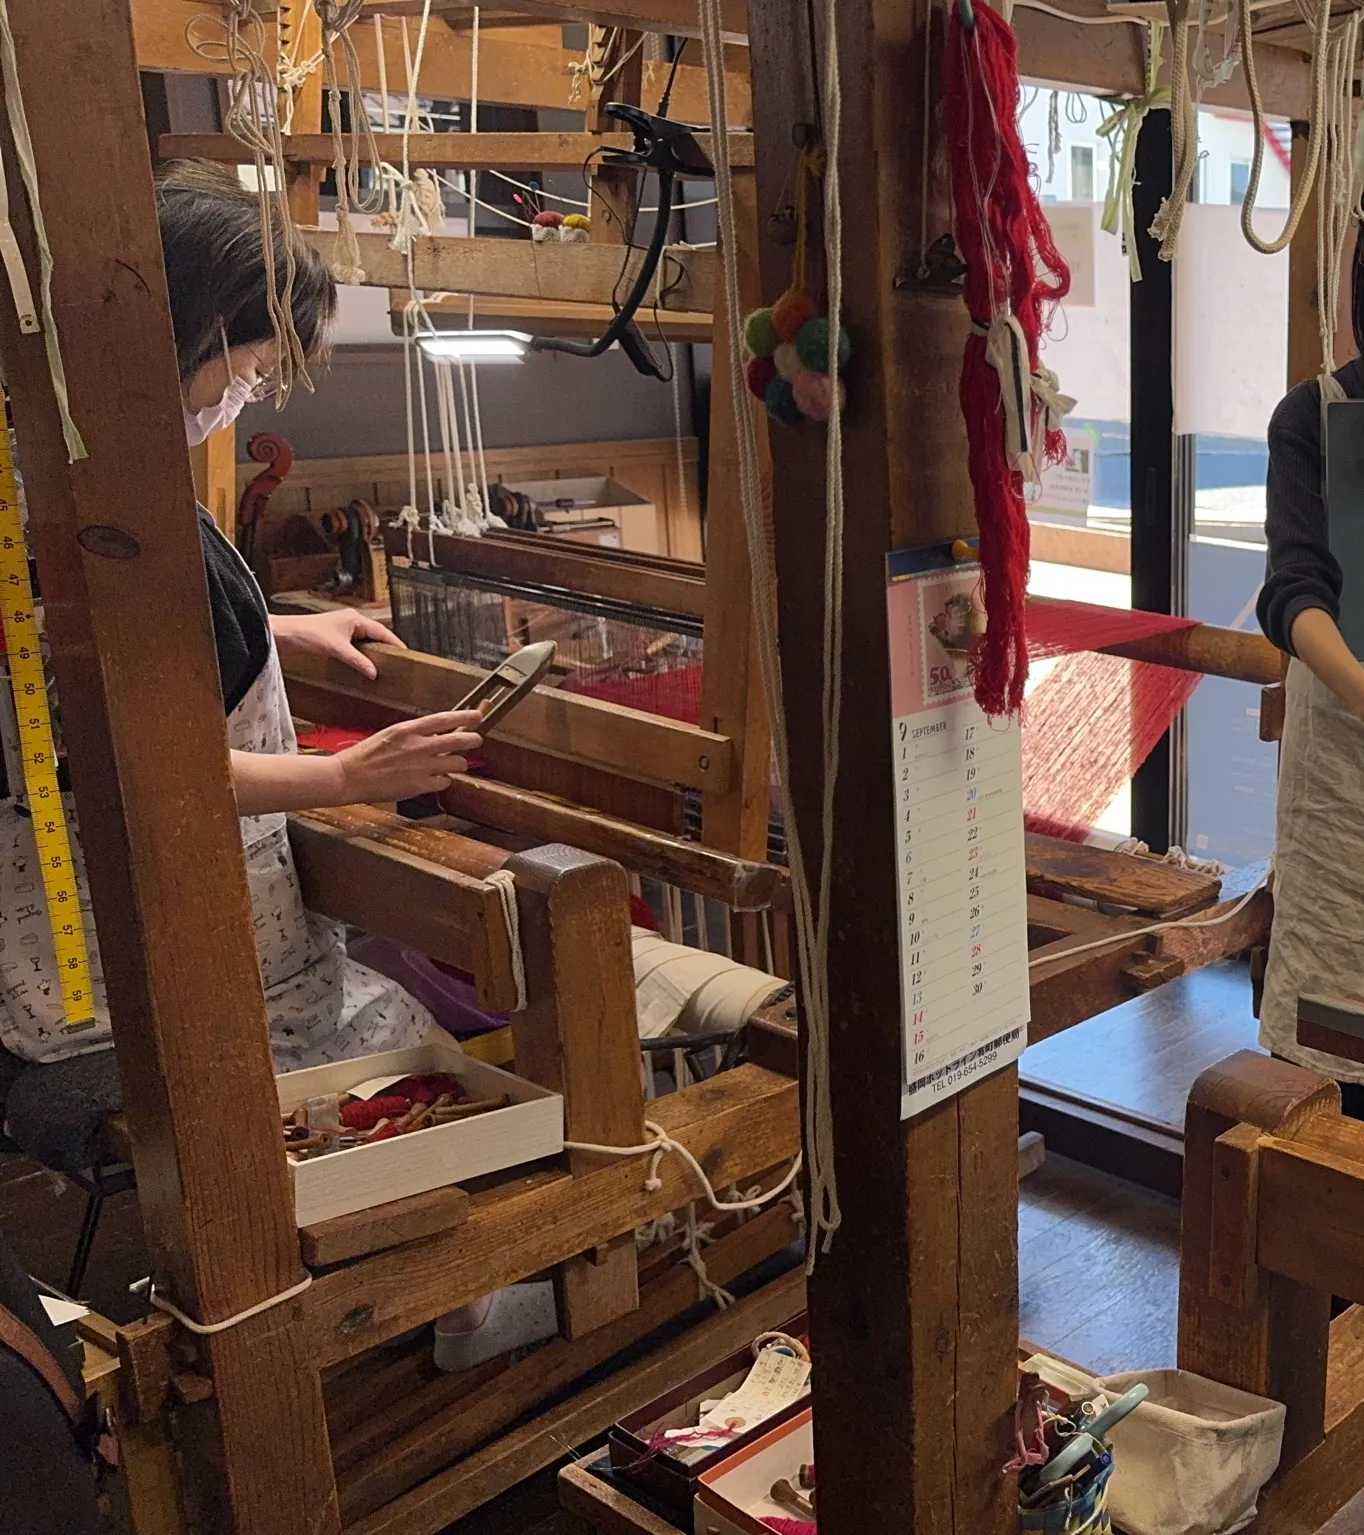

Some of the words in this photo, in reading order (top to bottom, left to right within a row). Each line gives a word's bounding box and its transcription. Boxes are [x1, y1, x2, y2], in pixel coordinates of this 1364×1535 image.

[3, 535, 14, 549] 46
[8, 573, 20, 587] 47
[13, 610, 25, 623] 48
[19, 646, 30, 660] 49
[929, 665, 950, 686] 50
[24, 682, 35, 696] 50
[29, 718, 40, 730] 51
[899, 721, 907, 742] 9
[911, 720, 948, 740] SEPTEMBER
[965, 726, 975, 741] 17
[34, 752, 44, 765] 52
[902, 747, 907, 760] 1
[965, 746, 975, 761] 18
[902, 767, 909, 781] 2
[966, 767, 976, 781] 19
[38, 785, 49, 799] 53
[903, 788, 910, 802] 3
[966, 787, 977, 801] 20
[904, 809, 910, 822] 4
[966, 807, 977, 821] 21
[44, 821, 56, 834] 54
[967, 826, 978, 841] 22
[905, 830, 911, 843] 5
[905, 851, 912, 864] 6
[968, 846, 978, 861] 23
[50, 855, 62, 869] 55
[907, 871, 913, 885] 7
[968, 866, 979, 881] 24
[57, 890, 68, 903] 56
[907, 892, 914, 905] 8
[969, 885, 980, 900] 25
[969, 904, 980, 919] 26
[908, 912, 915, 926] 9
[62, 924, 74, 936] 57
[970, 924, 980, 939] 27
[910, 931, 920, 945] 10
[970, 943, 981, 958] 28
[68, 957, 78, 970] 58
[911, 951, 920, 966] 11
[971, 962, 982, 977] 29
[911, 970, 922, 986] 12
[72, 989, 83, 1002] 59
[972, 982, 983, 996] 30
[912, 991, 922, 1005] 13
[912, 1008, 923, 1025] 14
[913, 1030, 924, 1045] 15
[914, 1050, 924, 1064] 16
[931, 1079, 946, 1093] TEL
[947, 1051, 997, 1085] 019-654-5299
